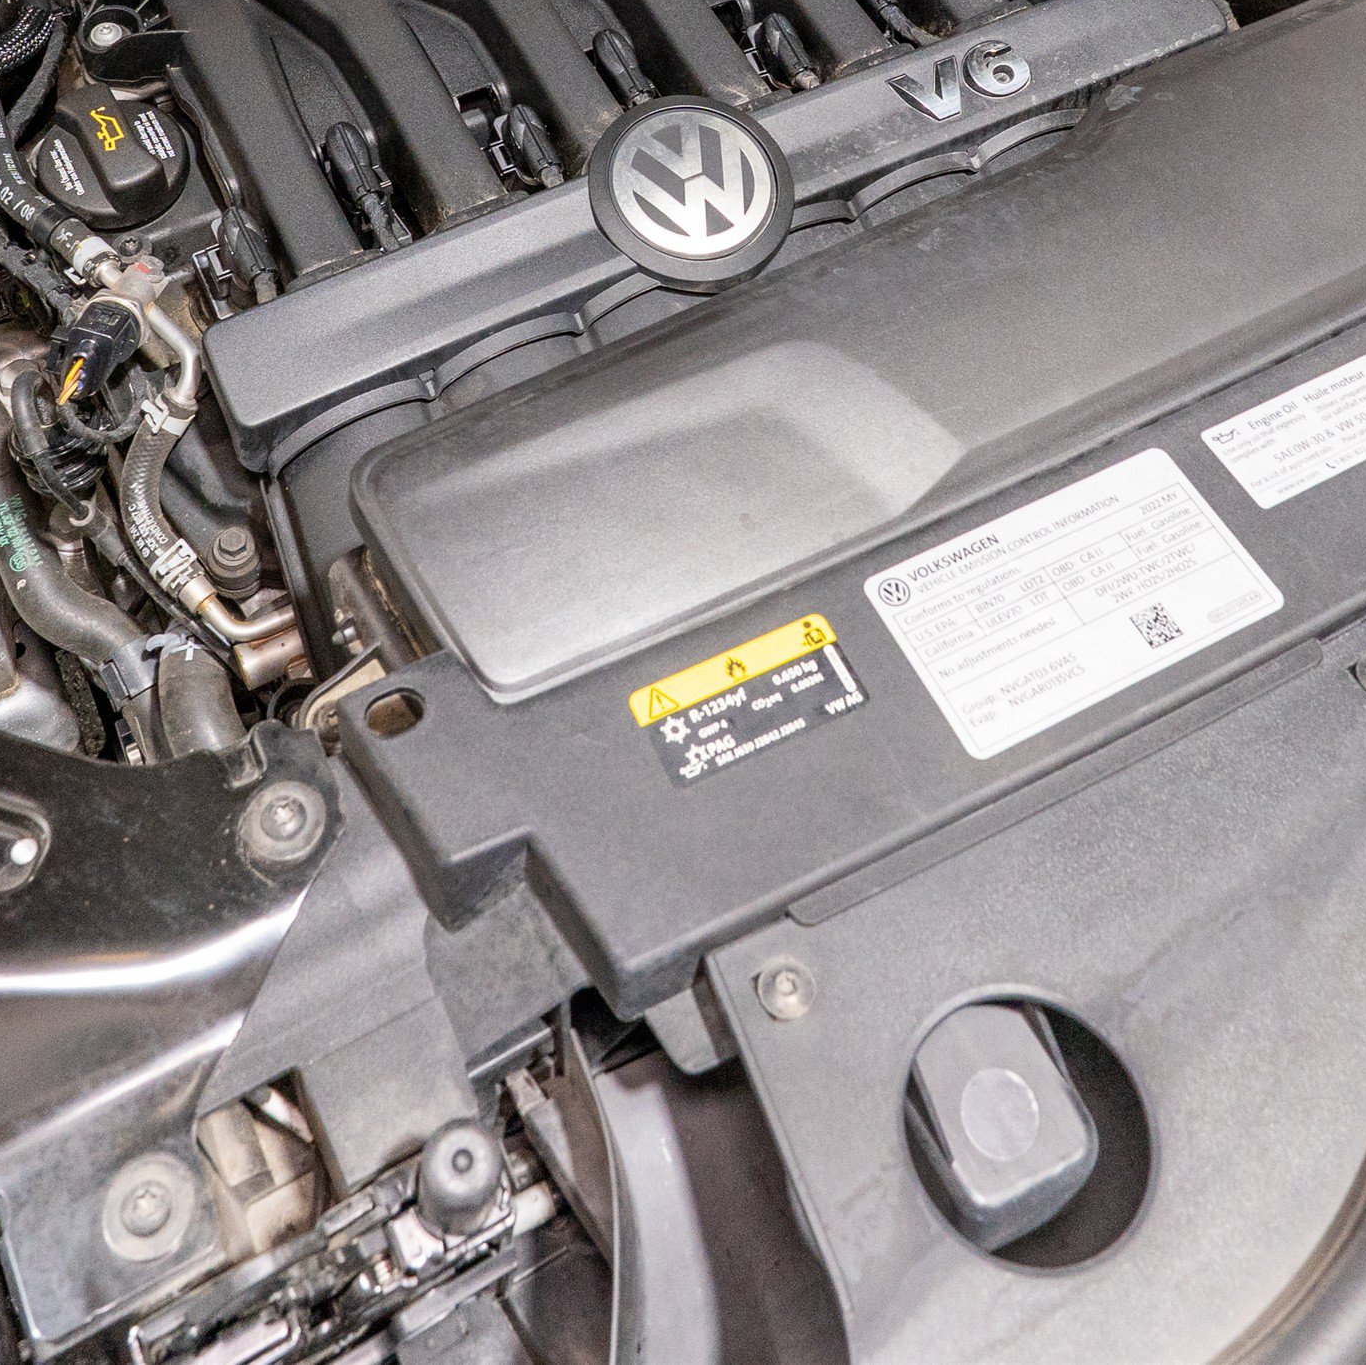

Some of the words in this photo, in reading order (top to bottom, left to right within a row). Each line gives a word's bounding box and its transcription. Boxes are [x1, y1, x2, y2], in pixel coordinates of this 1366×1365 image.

[886, 40, 1031, 122] V6
[1302, 385, 1331, 403] Huile
[1327, 369, 1366, 392] moteur
[1247, 408, 1285, 432] Engine
[1279, 400, 1299, 414] Oil
[1272, 447, 1296, 463] SAE
[1322, 428, 1335, 438] &
[1334, 418, 1356, 432] VW
[1137, 498, 1163, 515] 2022
[1160, 490, 1180, 504] MY
[1148, 505, 1191, 530] Gasoline
[915, 568, 958, 594] VEHICLE
[956, 545, 1007, 575] EMISSION
[1005, 524, 1053, 552] CONTROL
[1051, 493, 1120, 531] INFORMATION
[1160, 519, 1203, 544] Gasoline
[906, 532, 1000, 583] VOLKSWAGEN
[902, 596, 953, 626] Conforms
[963, 564, 1023, 599] regulations
[974, 593, 1007, 614] BIN70
[1018, 574, 1046, 592] LDT2
[937, 665, 956, 680] No
[953, 634, 1021, 674] adjustments
[685, 686, 750, 725] R-1234yf
[823, 697, 848, 716] VW
[842, 689, 864, 707] AG
[704, 732, 737, 756] PAG
